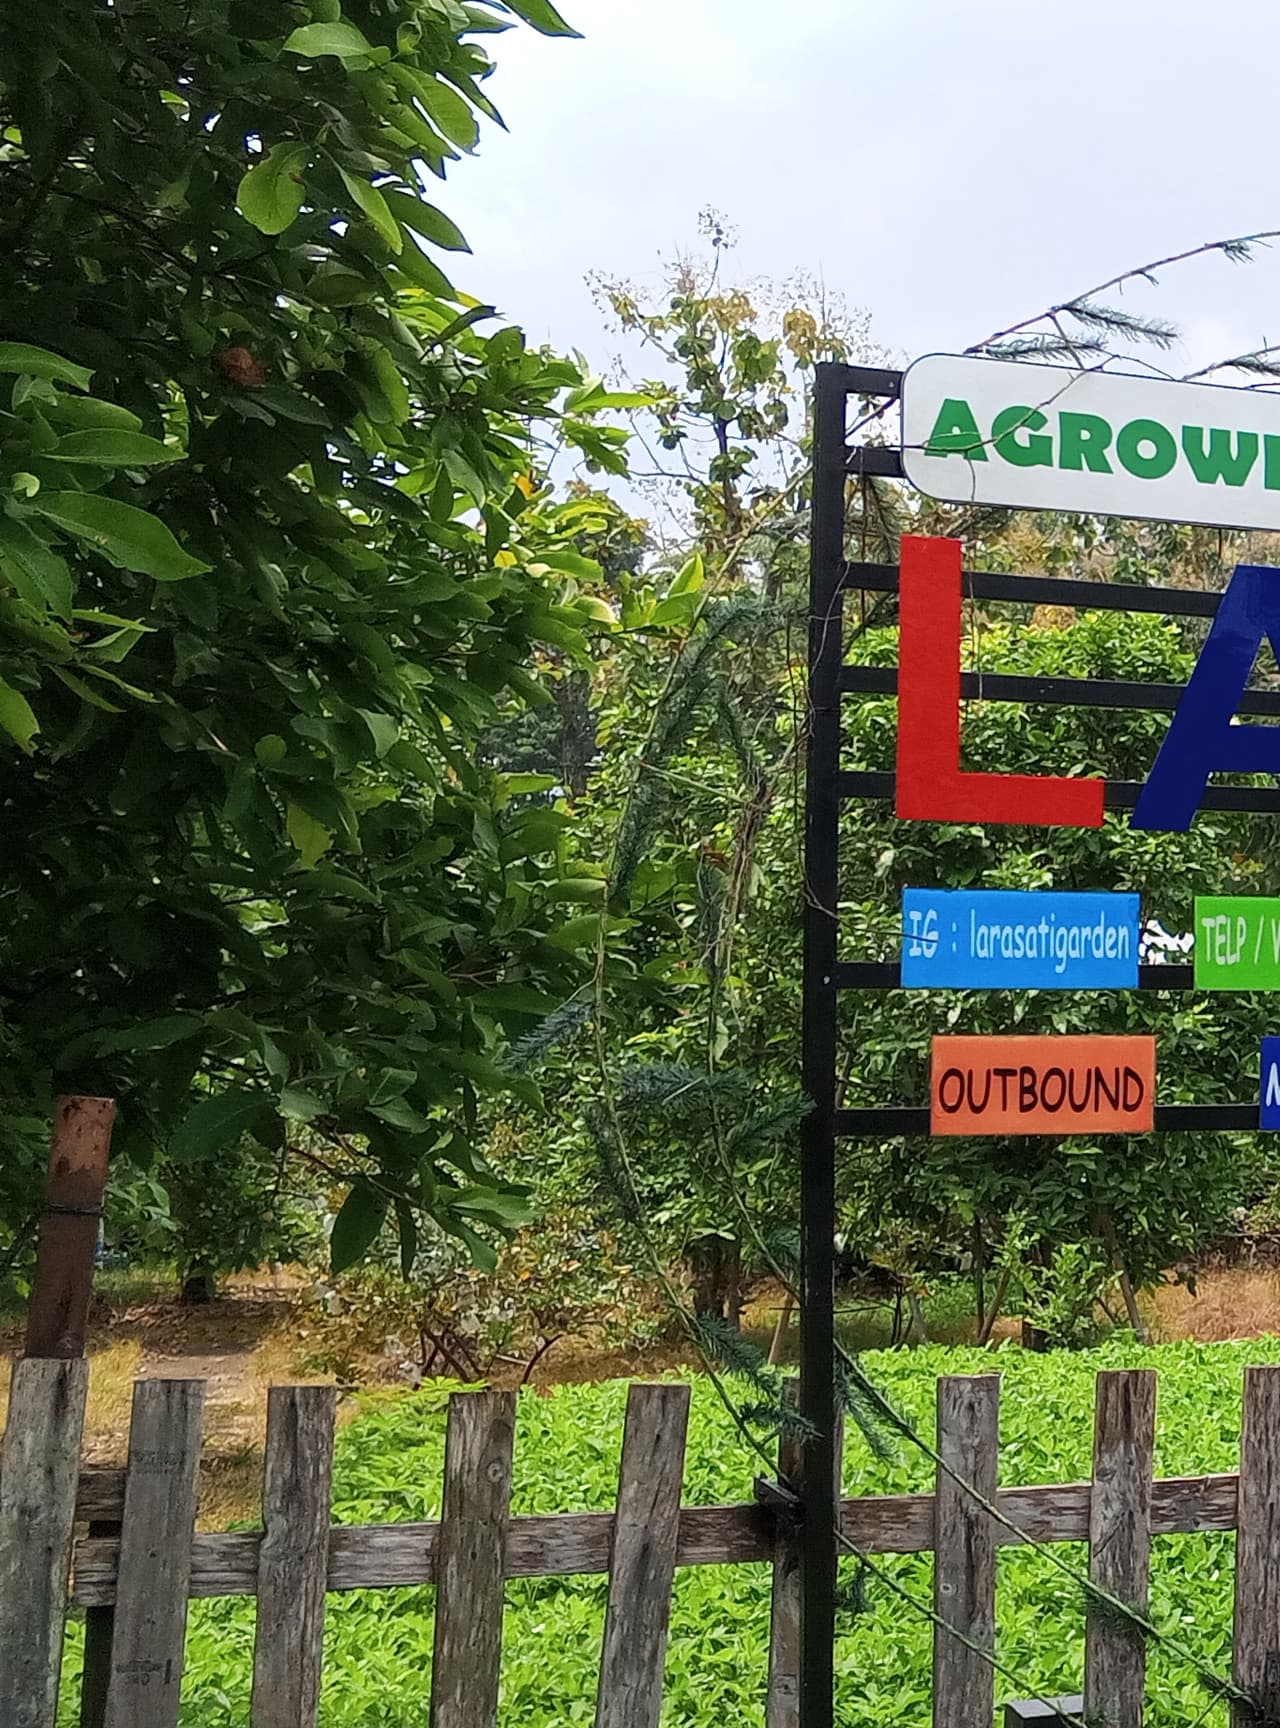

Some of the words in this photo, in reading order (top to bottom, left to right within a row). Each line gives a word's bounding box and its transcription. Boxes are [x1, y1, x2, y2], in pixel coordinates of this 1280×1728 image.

[908, 909, 939, 957] IG
[969, 909, 1131, 974] larasatigarden
[1202, 915, 1247, 966] TELP
[1254, 914, 1265, 965] /
[938, 1066, 1145, 1114] OUTBOUND
